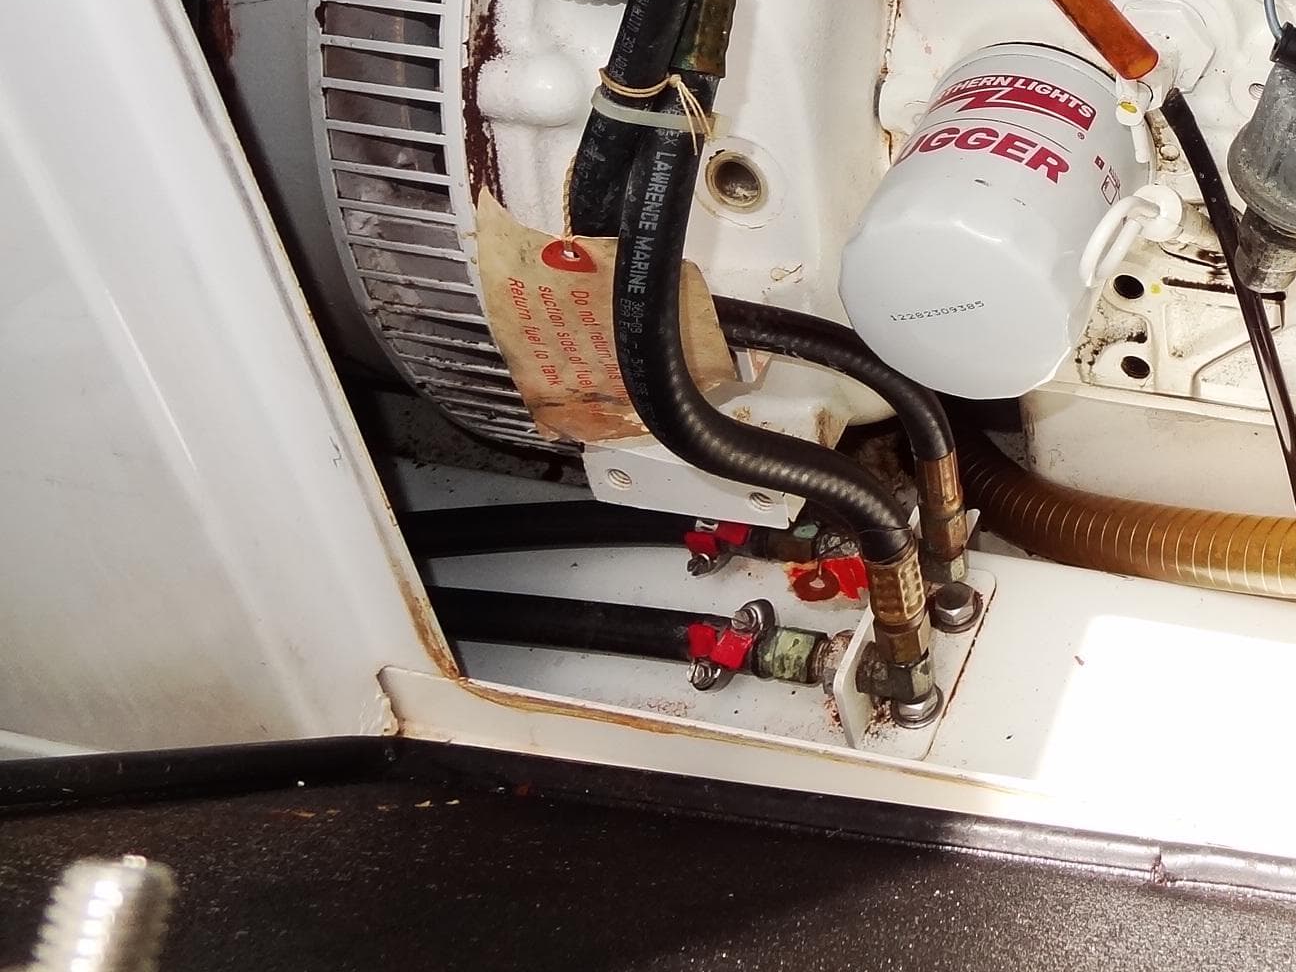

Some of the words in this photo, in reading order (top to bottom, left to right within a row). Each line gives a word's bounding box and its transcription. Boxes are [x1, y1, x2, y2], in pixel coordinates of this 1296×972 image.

[1018, 78, 1094, 118] LIGHTS
[638, 151, 677, 231] LAWRENCE
[627, 235, 655, 295] MARINE
[507, 277, 532, 321] Return
[538, 285, 565, 328] suction
[570, 290, 589, 306] Do
[579, 309, 600, 327] not
[524, 325, 547, 346] fuel
[557, 331, 578, 354] side
[591, 330, 613, 359] return
[534, 349, 549, 360] to
[569, 355, 588, 367] of
[576, 370, 598, 389] fuel
[604, 363, 622, 381] this
